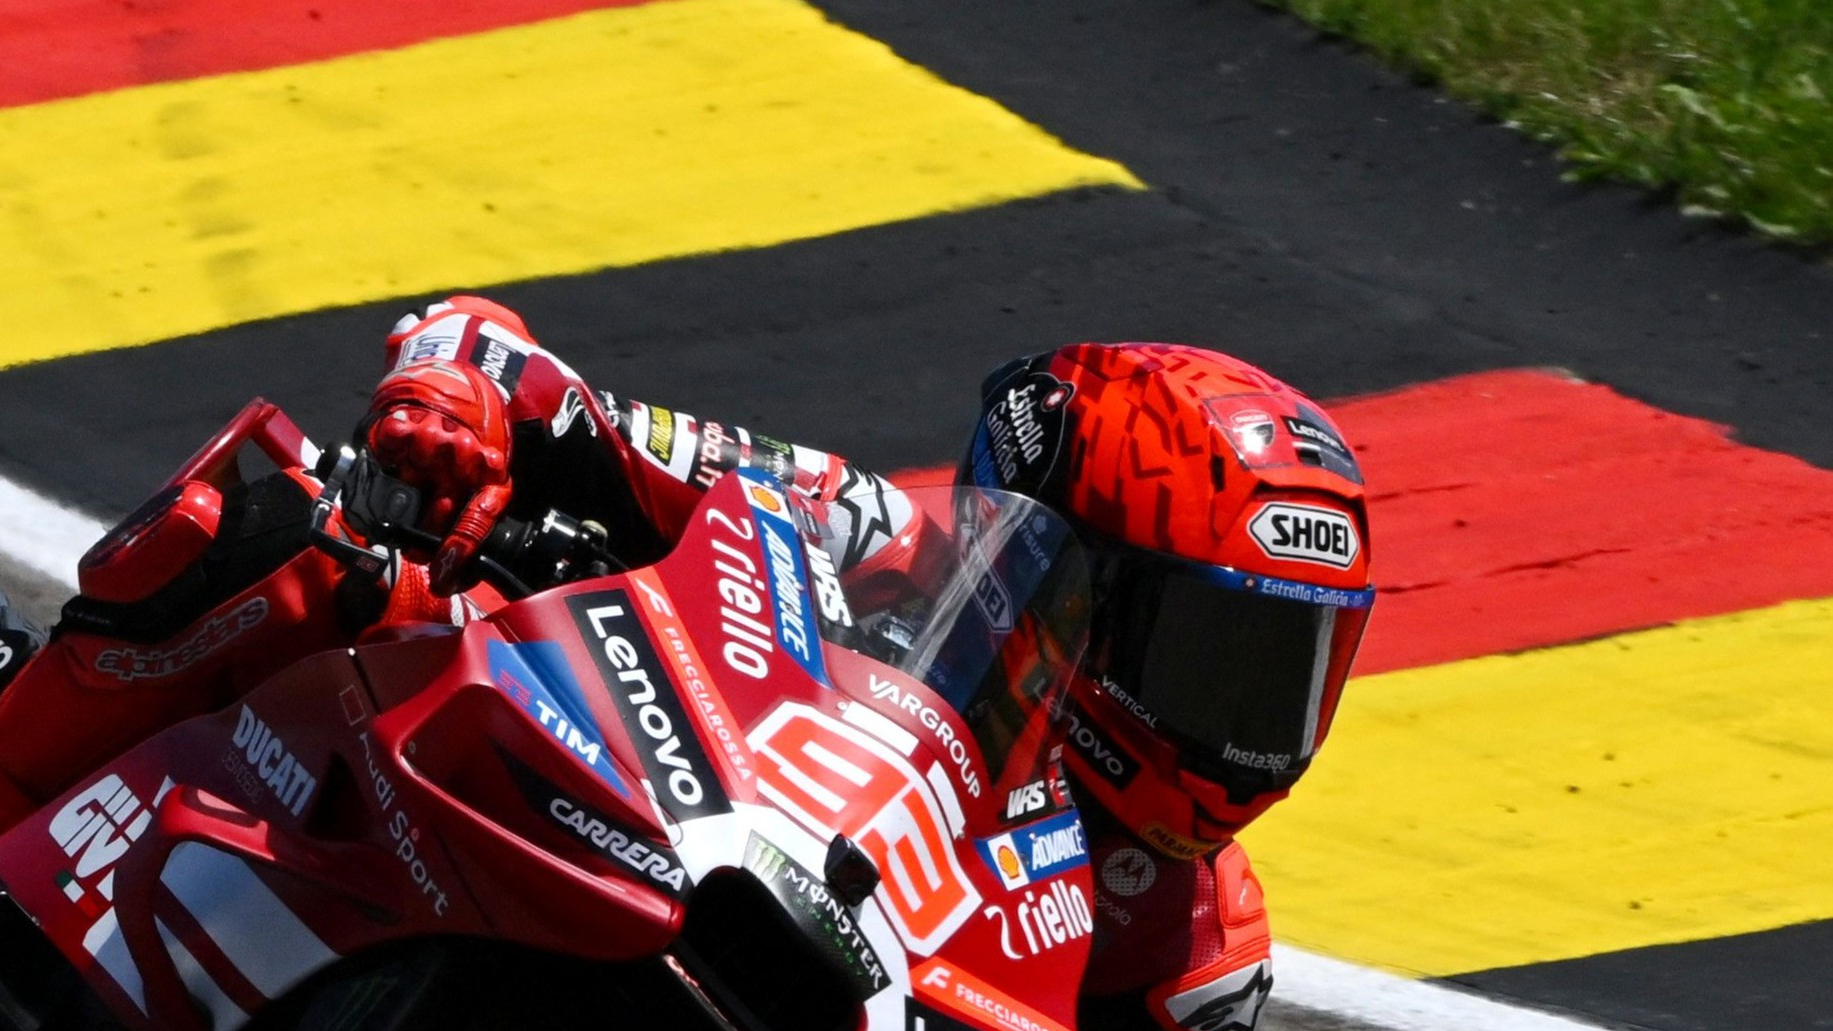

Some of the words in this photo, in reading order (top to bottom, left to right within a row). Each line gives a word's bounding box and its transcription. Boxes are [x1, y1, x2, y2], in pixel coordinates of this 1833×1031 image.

[479, 340, 516, 380] Lenovo
[1007, 384, 1045, 464] Estrella
[1288, 420, 1346, 452] Lenovo
[1271, 514, 1349, 557] SHOEI
[711, 539, 773, 680] riello
[761, 520, 810, 661] ADVANCE
[803, 539, 854, 628] WRS
[1261, 579, 1312, 601] Estrella
[1313, 587, 1349, 607] Galicia
[535, 699, 602, 766] TIM
[586, 605, 704, 806] Lenovo
[666, 627, 753, 781] FRECCIAROSSA
[868, 674, 981, 799] VARGROUP
[1101, 675, 1159, 729] VERTICAL
[232, 703, 317, 817] DUCATI
[1006, 780, 1045, 819] WRS
[1222, 742, 1291, 773] Insta360
[388, 810, 450, 917] Sport
[549, 797, 686, 892] CARRERA
[755, 714, 968, 941] 93
[1031, 823, 1085, 870] ADVANCE
[784, 868, 884, 990] MONSTER
[1018, 879, 1094, 955] riello
